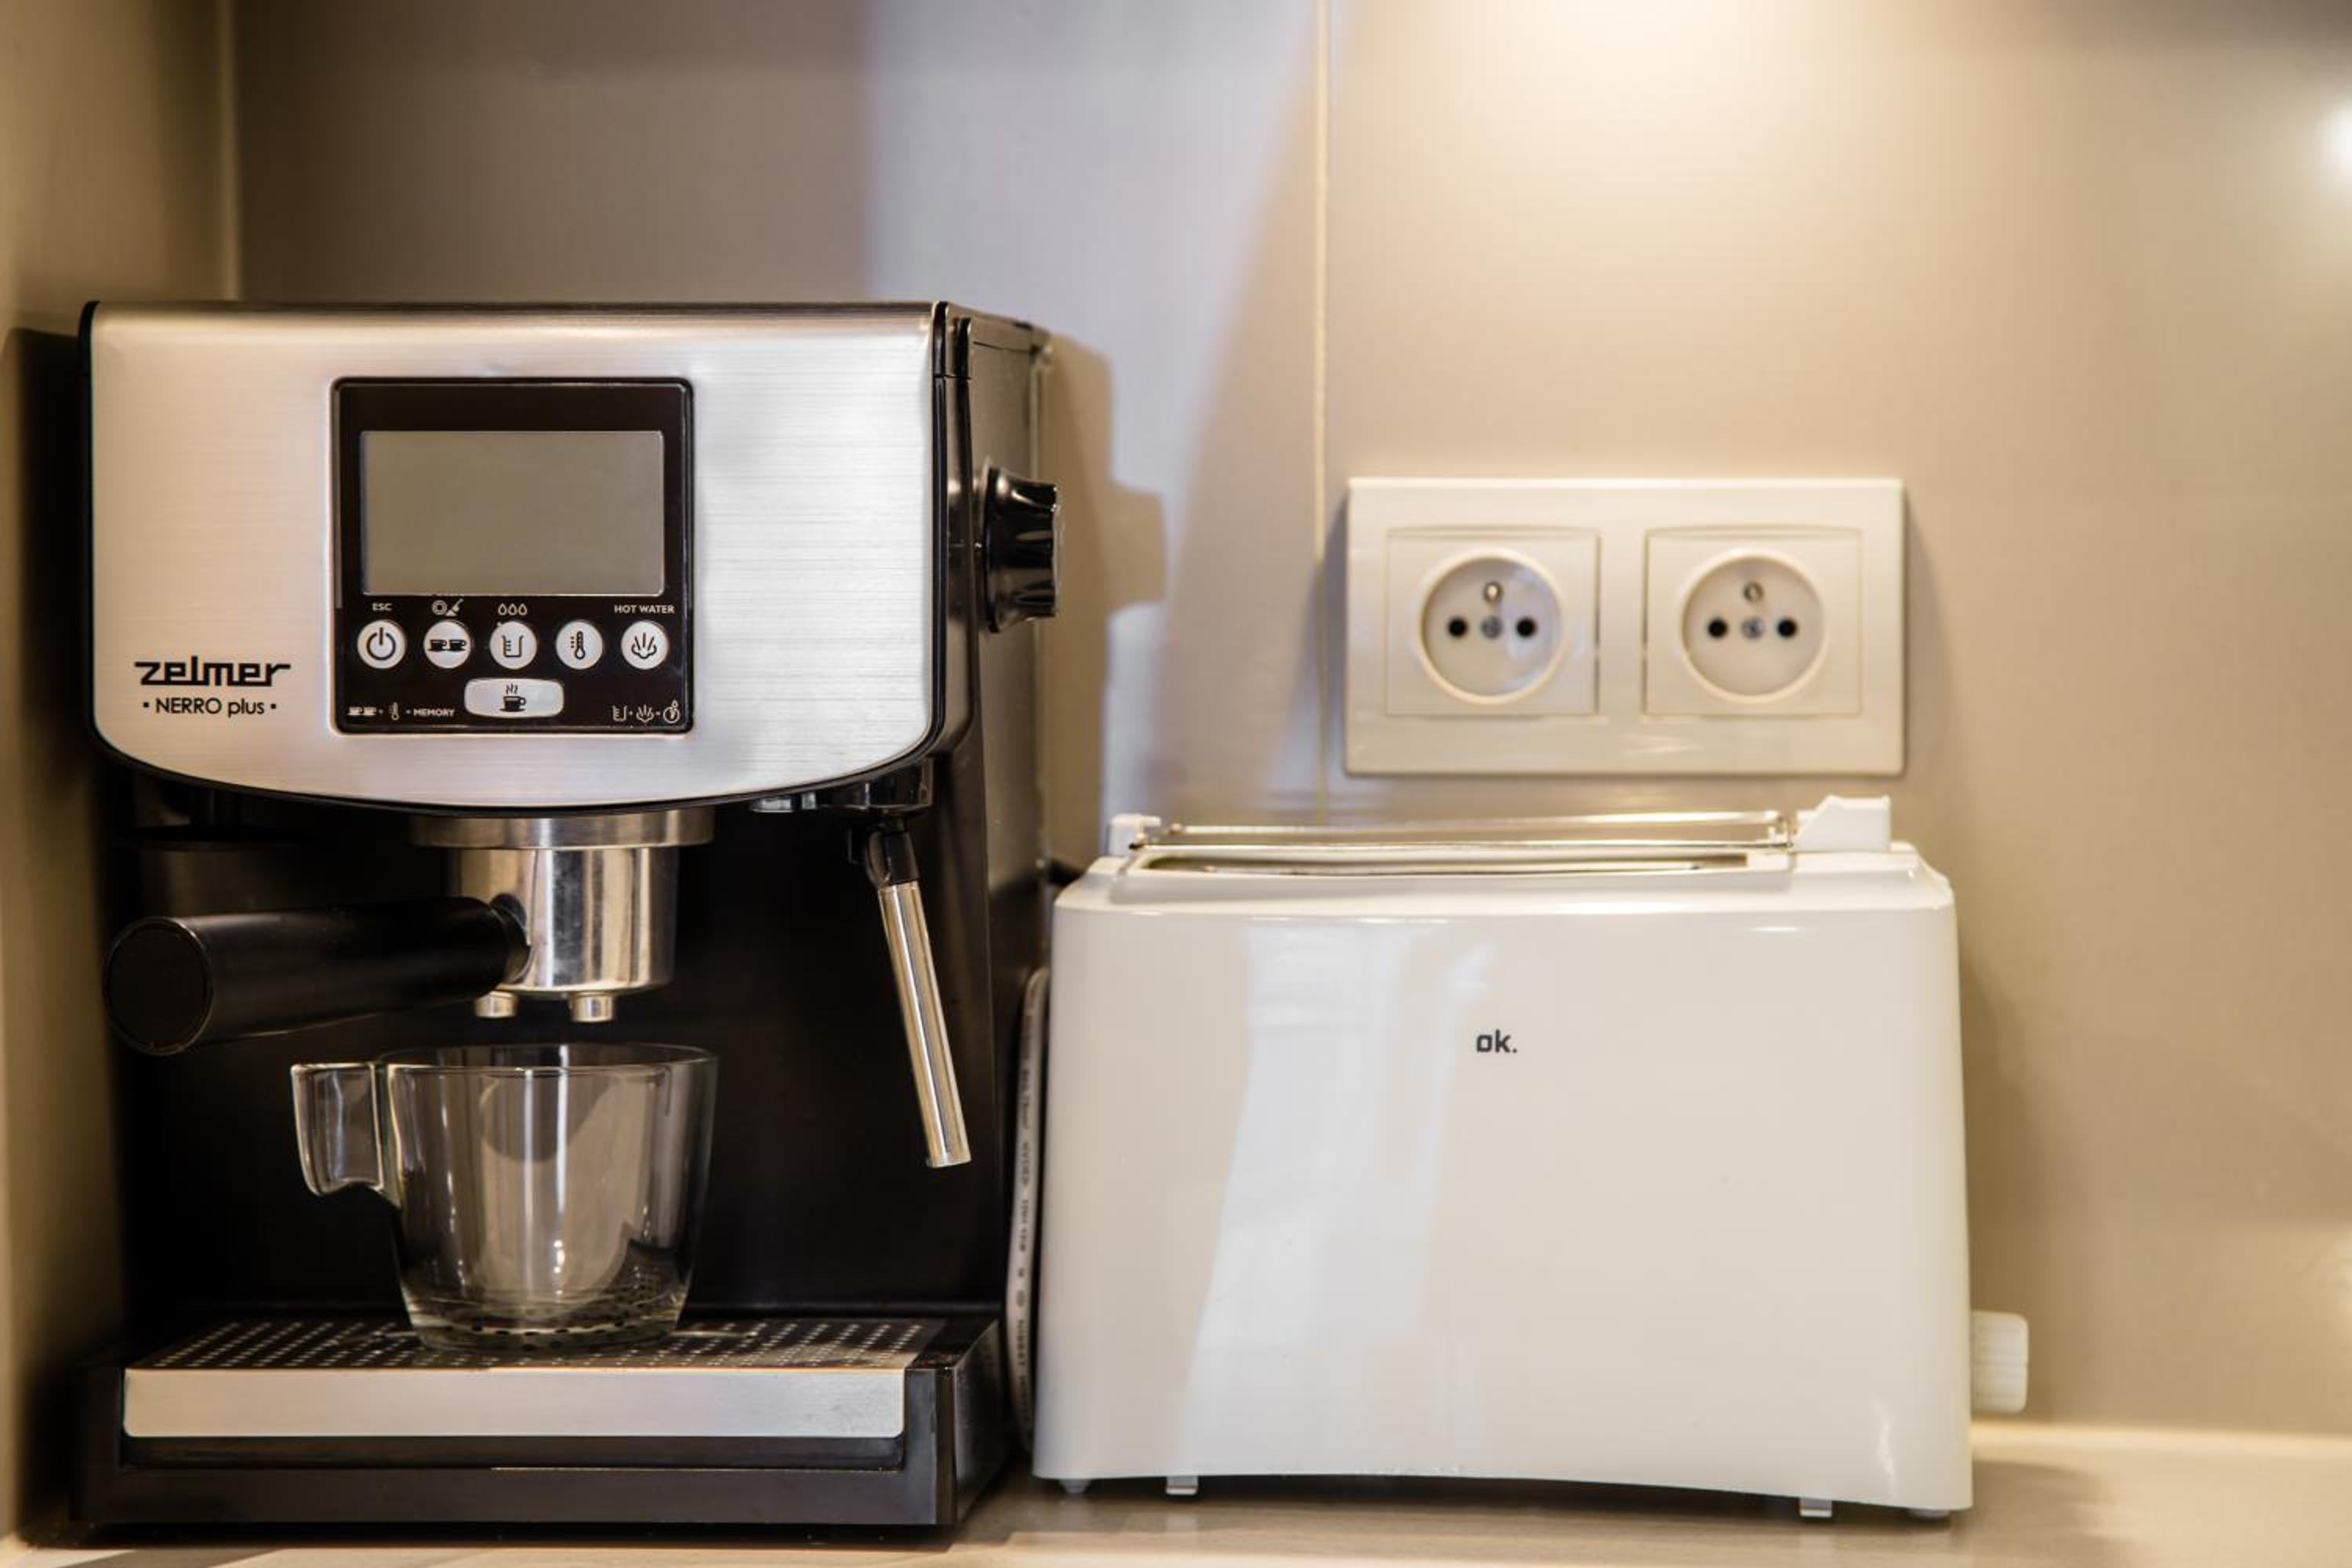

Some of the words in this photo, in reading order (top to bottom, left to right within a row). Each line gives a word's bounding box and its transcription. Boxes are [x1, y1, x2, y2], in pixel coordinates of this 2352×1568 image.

[372, 603, 392, 612] ESC
[614, 604, 637, 614] HOT
[640, 604, 675, 614] WATER
[134, 655, 291, 687] zelmer
[156, 697, 222, 714] NERRO
[228, 698, 265, 717] plus
[413, 707, 455, 717] MEMORY
[1476, 1028, 1518, 1053] ok.
